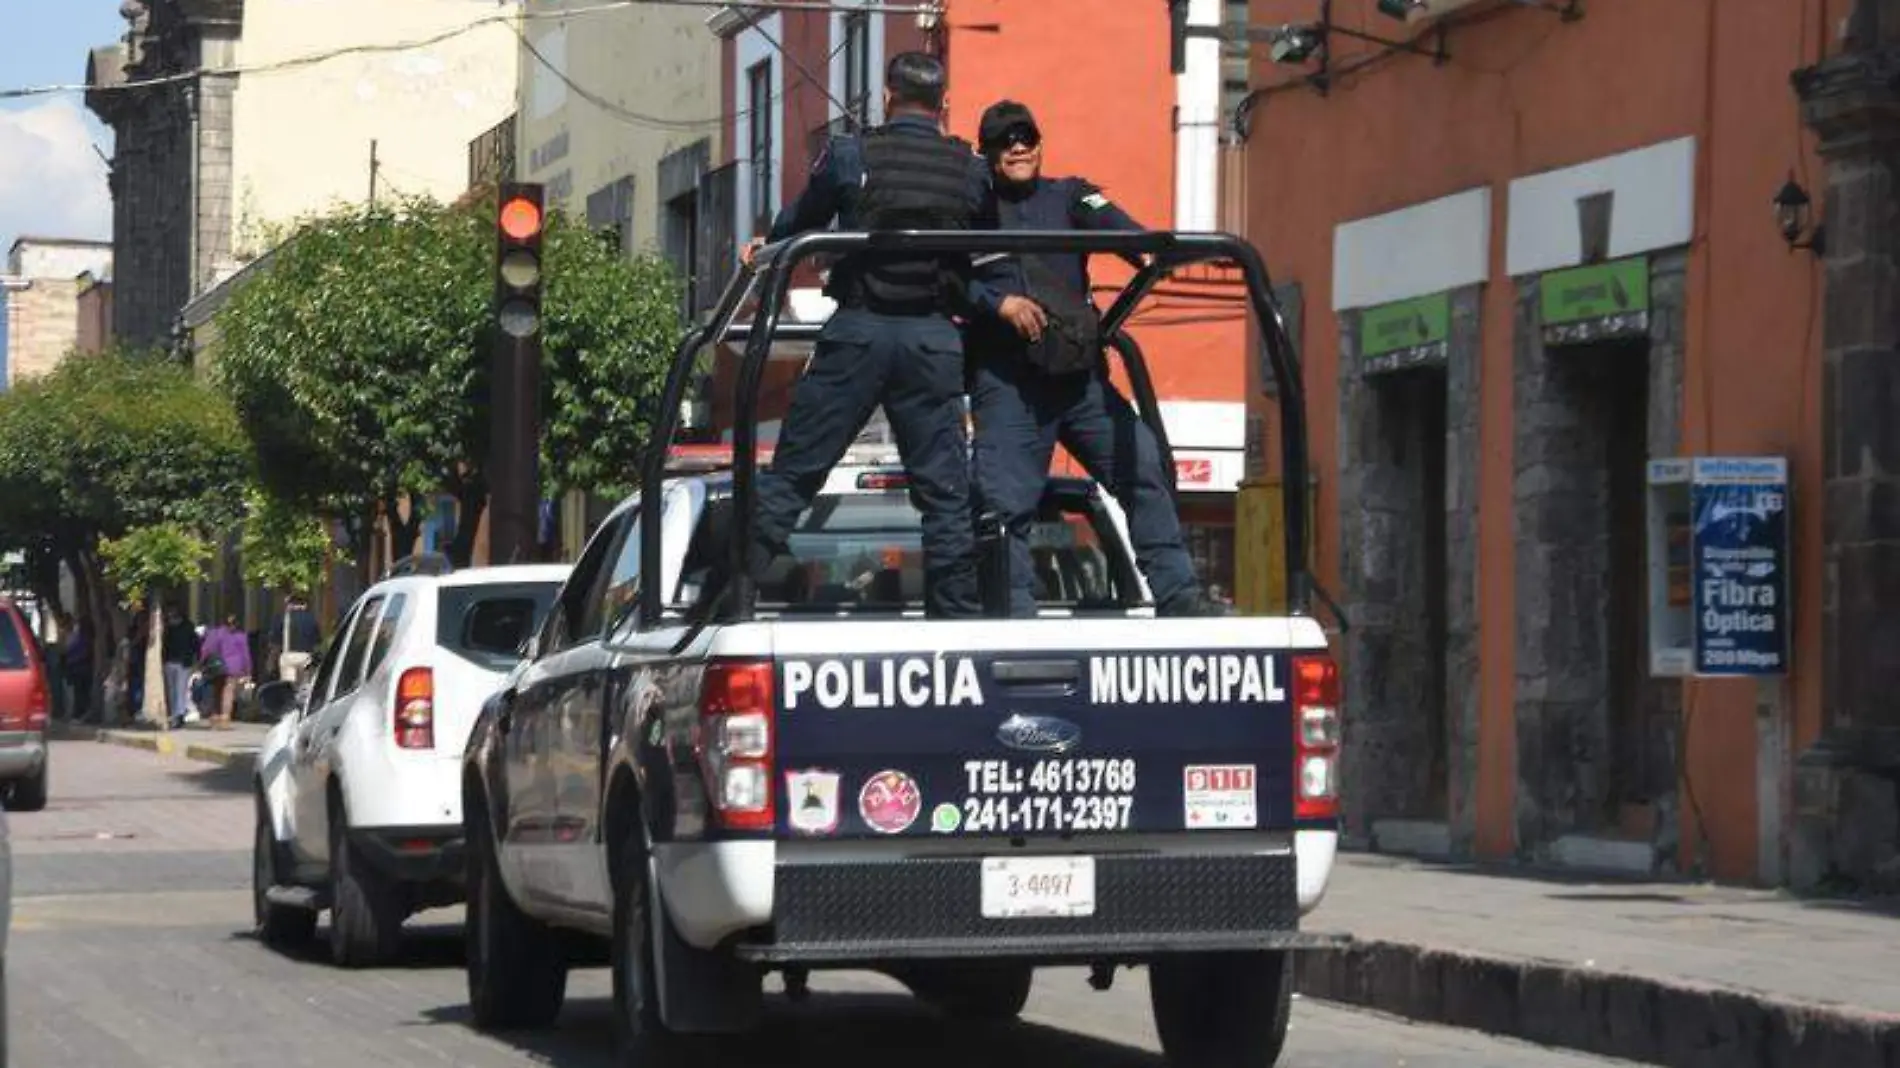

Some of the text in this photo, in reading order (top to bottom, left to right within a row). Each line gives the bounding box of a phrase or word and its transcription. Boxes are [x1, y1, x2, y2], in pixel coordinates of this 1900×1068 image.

[1704, 579, 1775, 606] Fibra
[784, 651, 1285, 708] POLICÍA MUNICIPAL
[965, 759, 1136, 793] TEL: 4613768
[1190, 771, 1247, 790] 911
[964, 796, 1134, 831] 241-171-2397
[1008, 873, 1073, 897] 3-4497
